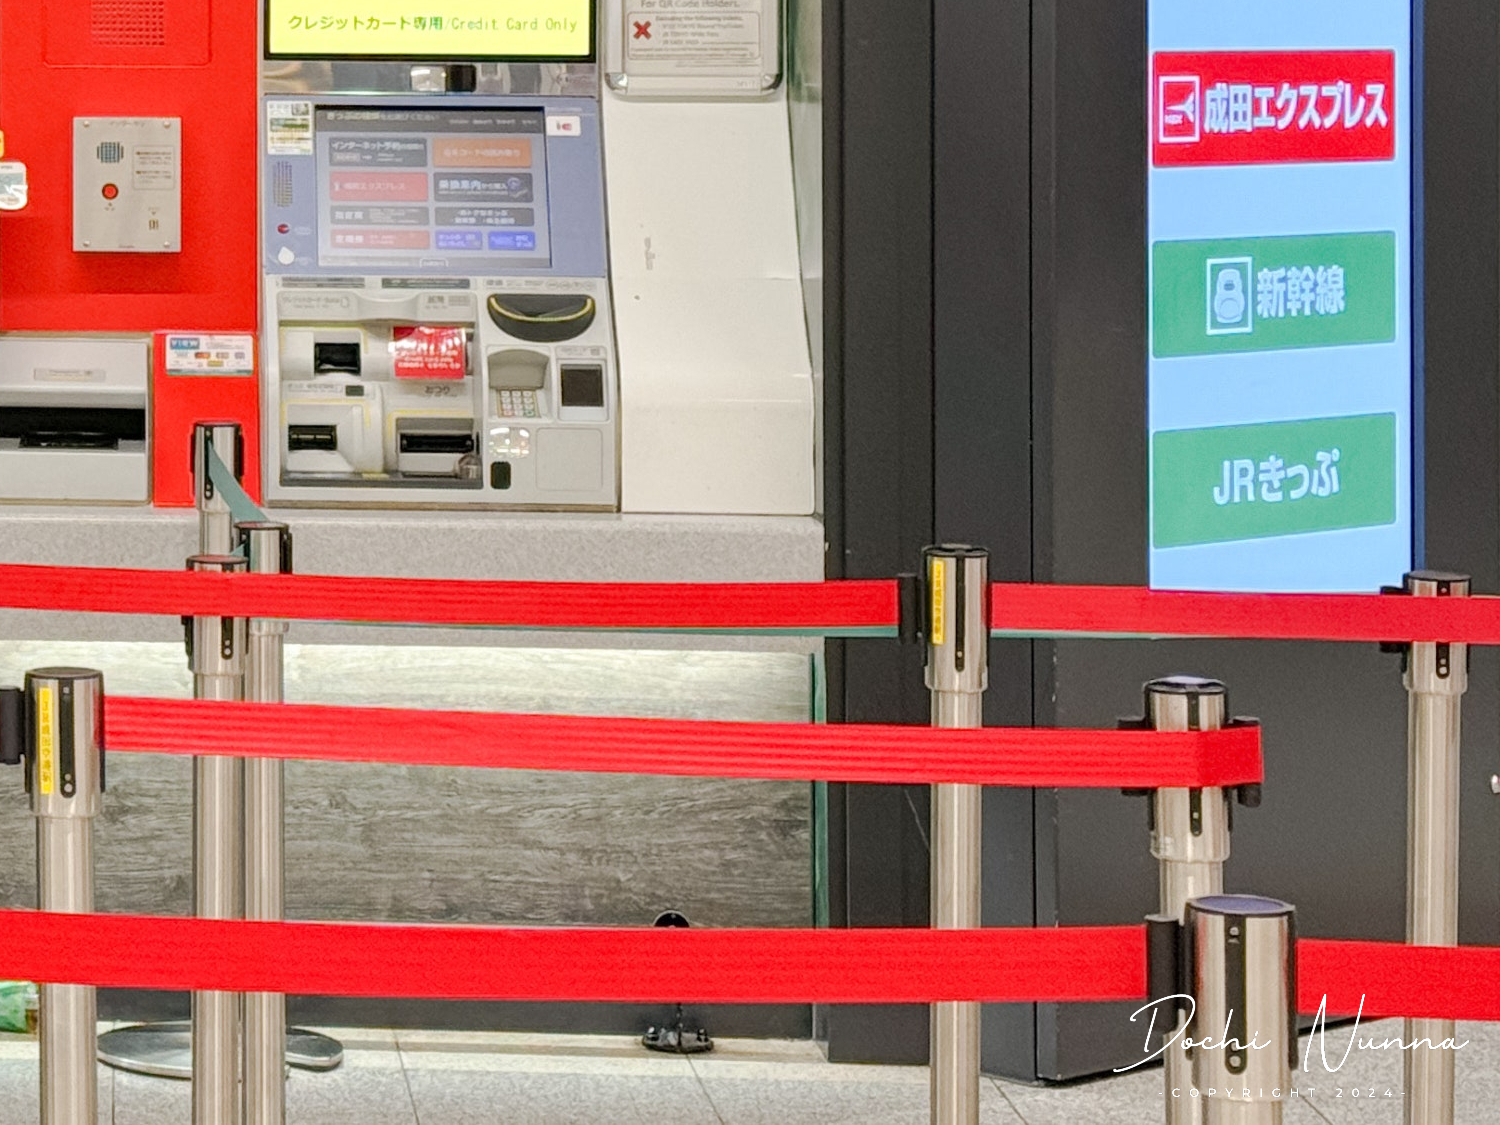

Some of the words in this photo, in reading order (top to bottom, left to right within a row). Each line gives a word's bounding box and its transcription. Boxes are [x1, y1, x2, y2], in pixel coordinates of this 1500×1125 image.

[506, 18, 538, 31] Card
[545, 18, 578, 33] Only
[659, 0, 674, 8] QR
[1203, 82, 1389, 133] 成田エクスプレス
[1256, 265, 1346, 317] 新幹線
[1213, 449, 1342, 507] JRきっぷ
